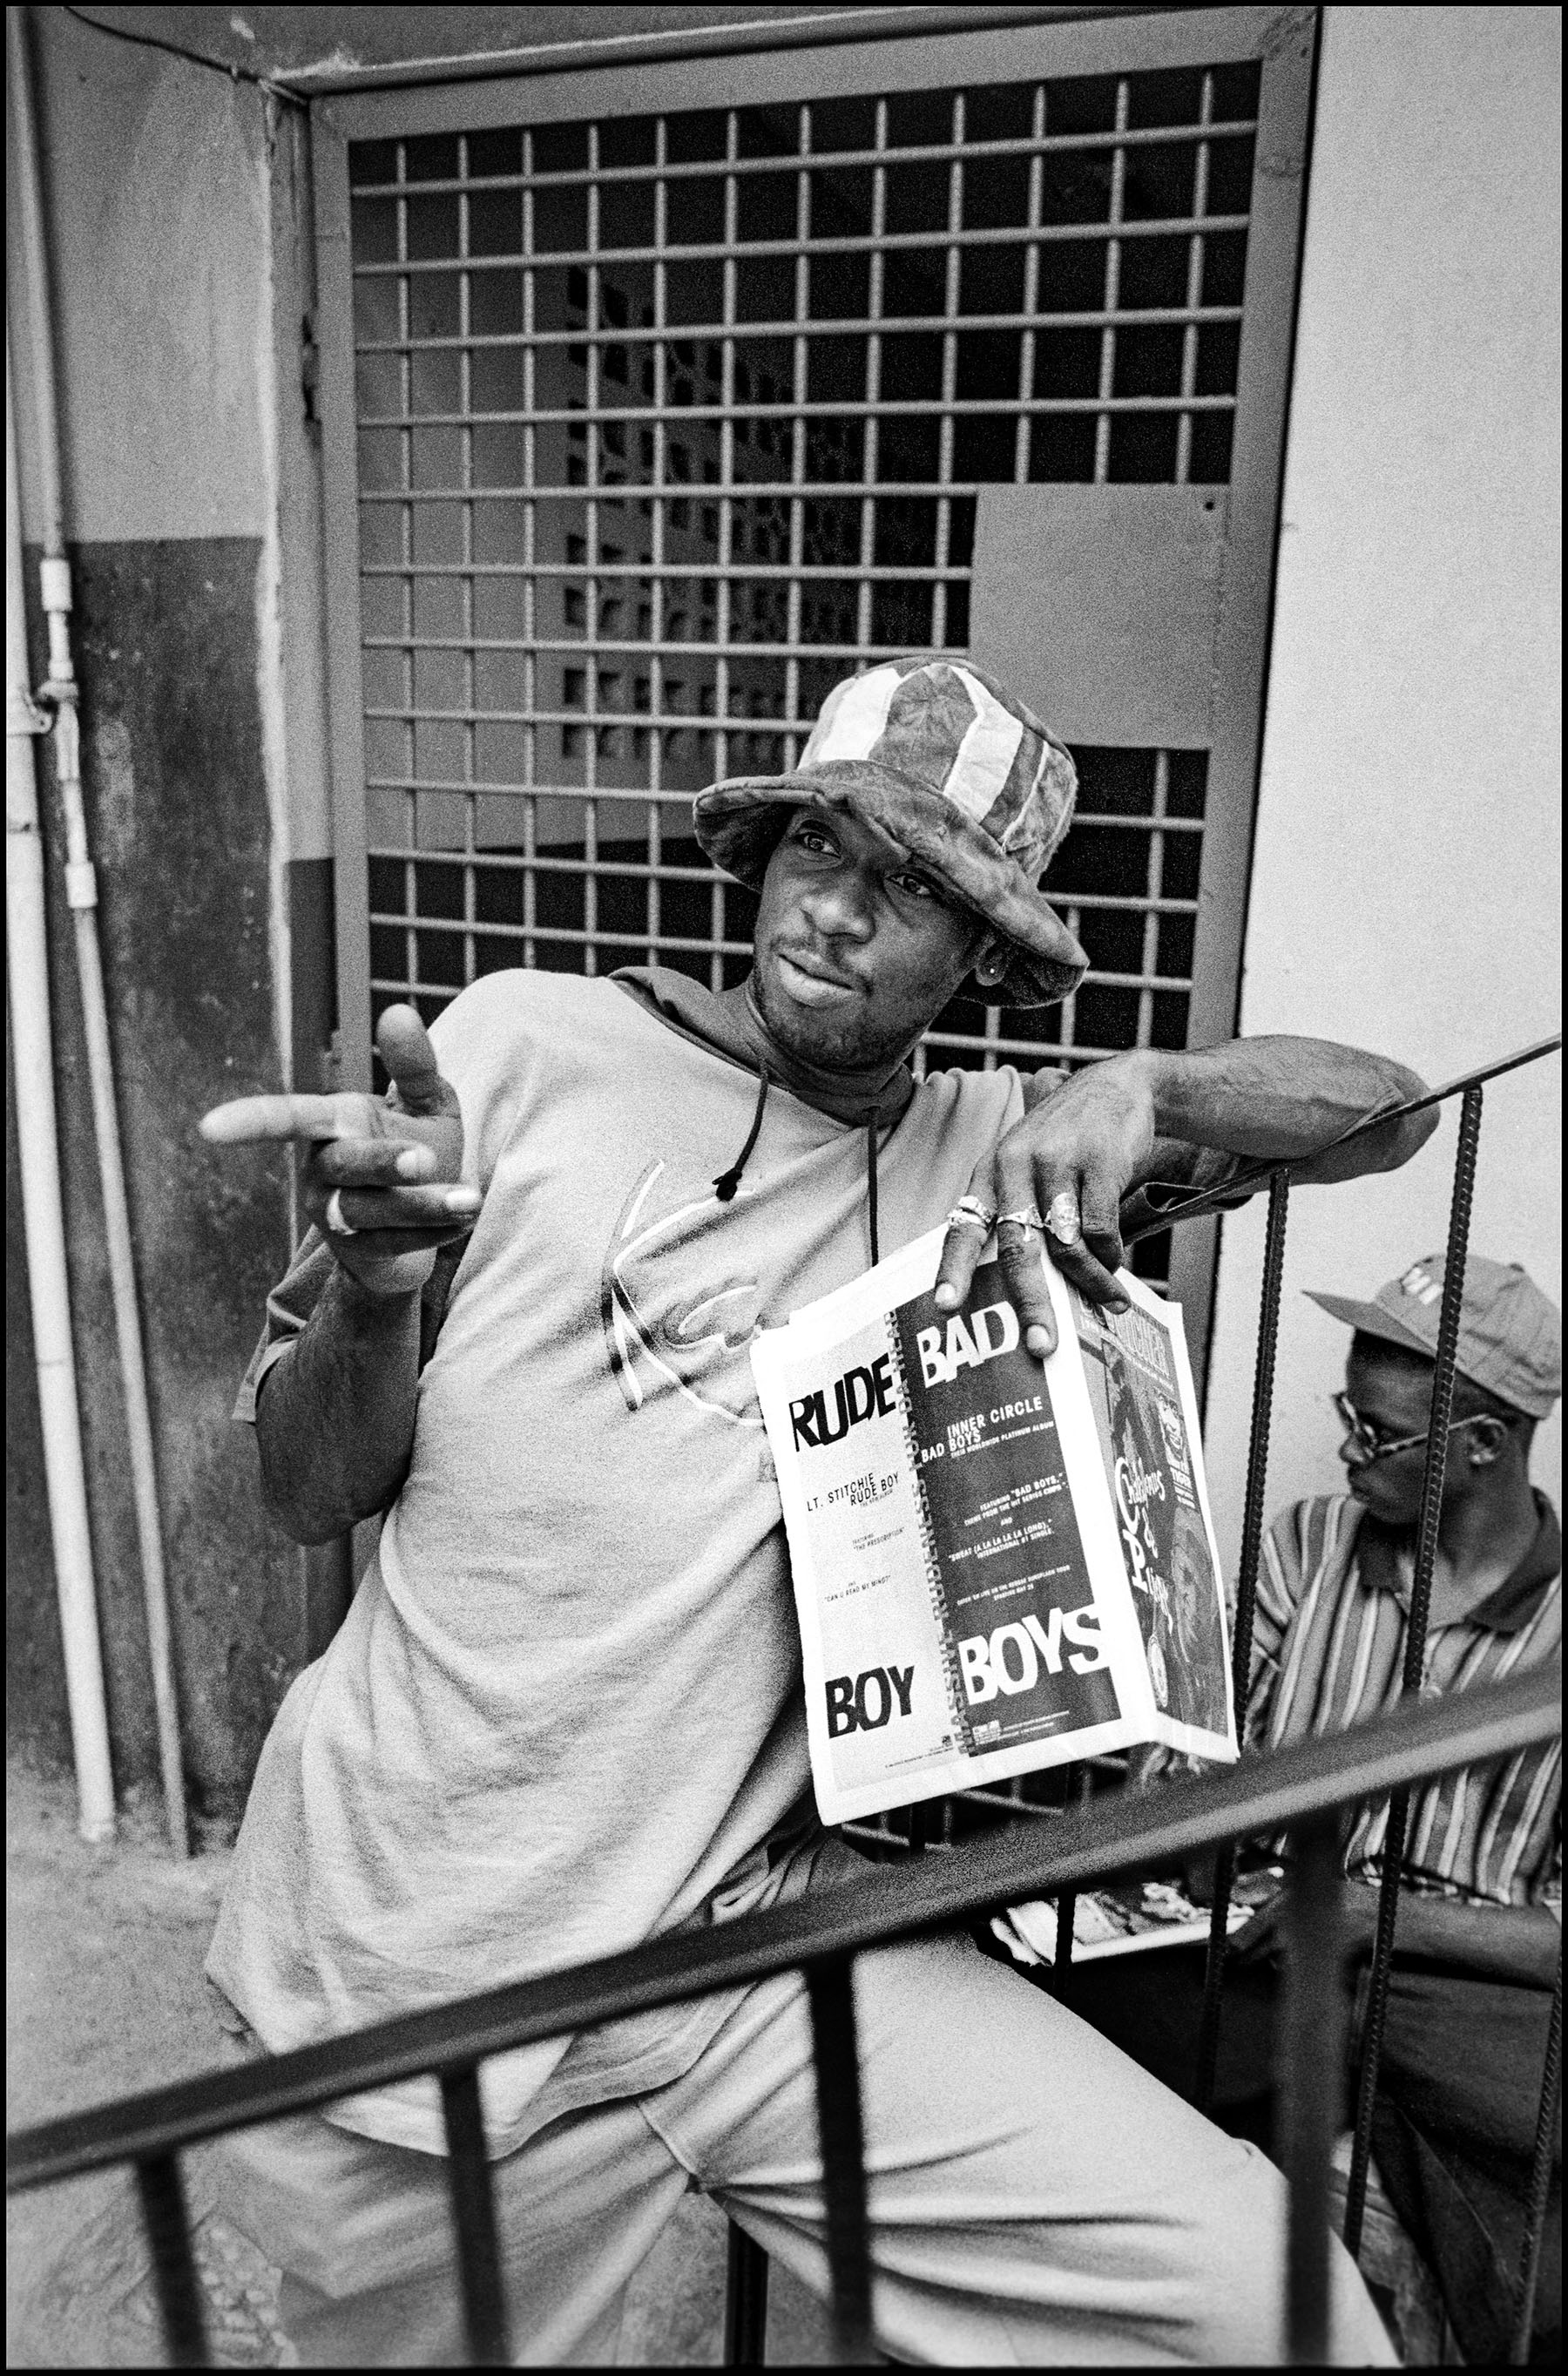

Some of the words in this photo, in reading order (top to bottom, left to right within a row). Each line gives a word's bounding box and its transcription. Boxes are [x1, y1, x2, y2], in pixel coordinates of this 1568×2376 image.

[916, 1300, 1020, 1389] BAD
[788, 1352, 896, 1452] RUDE
[947, 1413, 986, 1439] INNER
[990, 1396, 1044, 1424] CIRCLE
[921, 1443, 945, 1464] BAD
[948, 1427, 982, 1452] BOYS
[966, 1437, 1000, 1453] WORLDWIDE
[1001, 1426, 1031, 1442] PLATINUM
[1032, 1420, 1055, 1433] ALBUM
[807, 1497, 823, 1512] LT.
[828, 1472, 874, 1504] STITCHIE
[850, 1484, 877, 1506] RUDE
[881, 1472, 898, 1492] BOY
[979, 1494, 1010, 1512] FEATURING
[982, 1507, 998, 1519] FROM
[998, 1502, 1010, 1513] THE
[1021, 1490, 1043, 1503] SERIES
[911, 1479, 950, 1621] RUDENESS
[977, 1539, 1020, 1559] INTERNATIONAL
[983, 1540, 992, 1550] LA
[993, 1537, 1002, 1547] LA
[1003, 1533, 1012, 1542] LA
[1013, 1529, 1023, 1540] LA
[845, 1586, 860, 1596] READ
[957, 1602, 1109, 1706] BOYS
[825, 1665, 915, 1739] BOY
